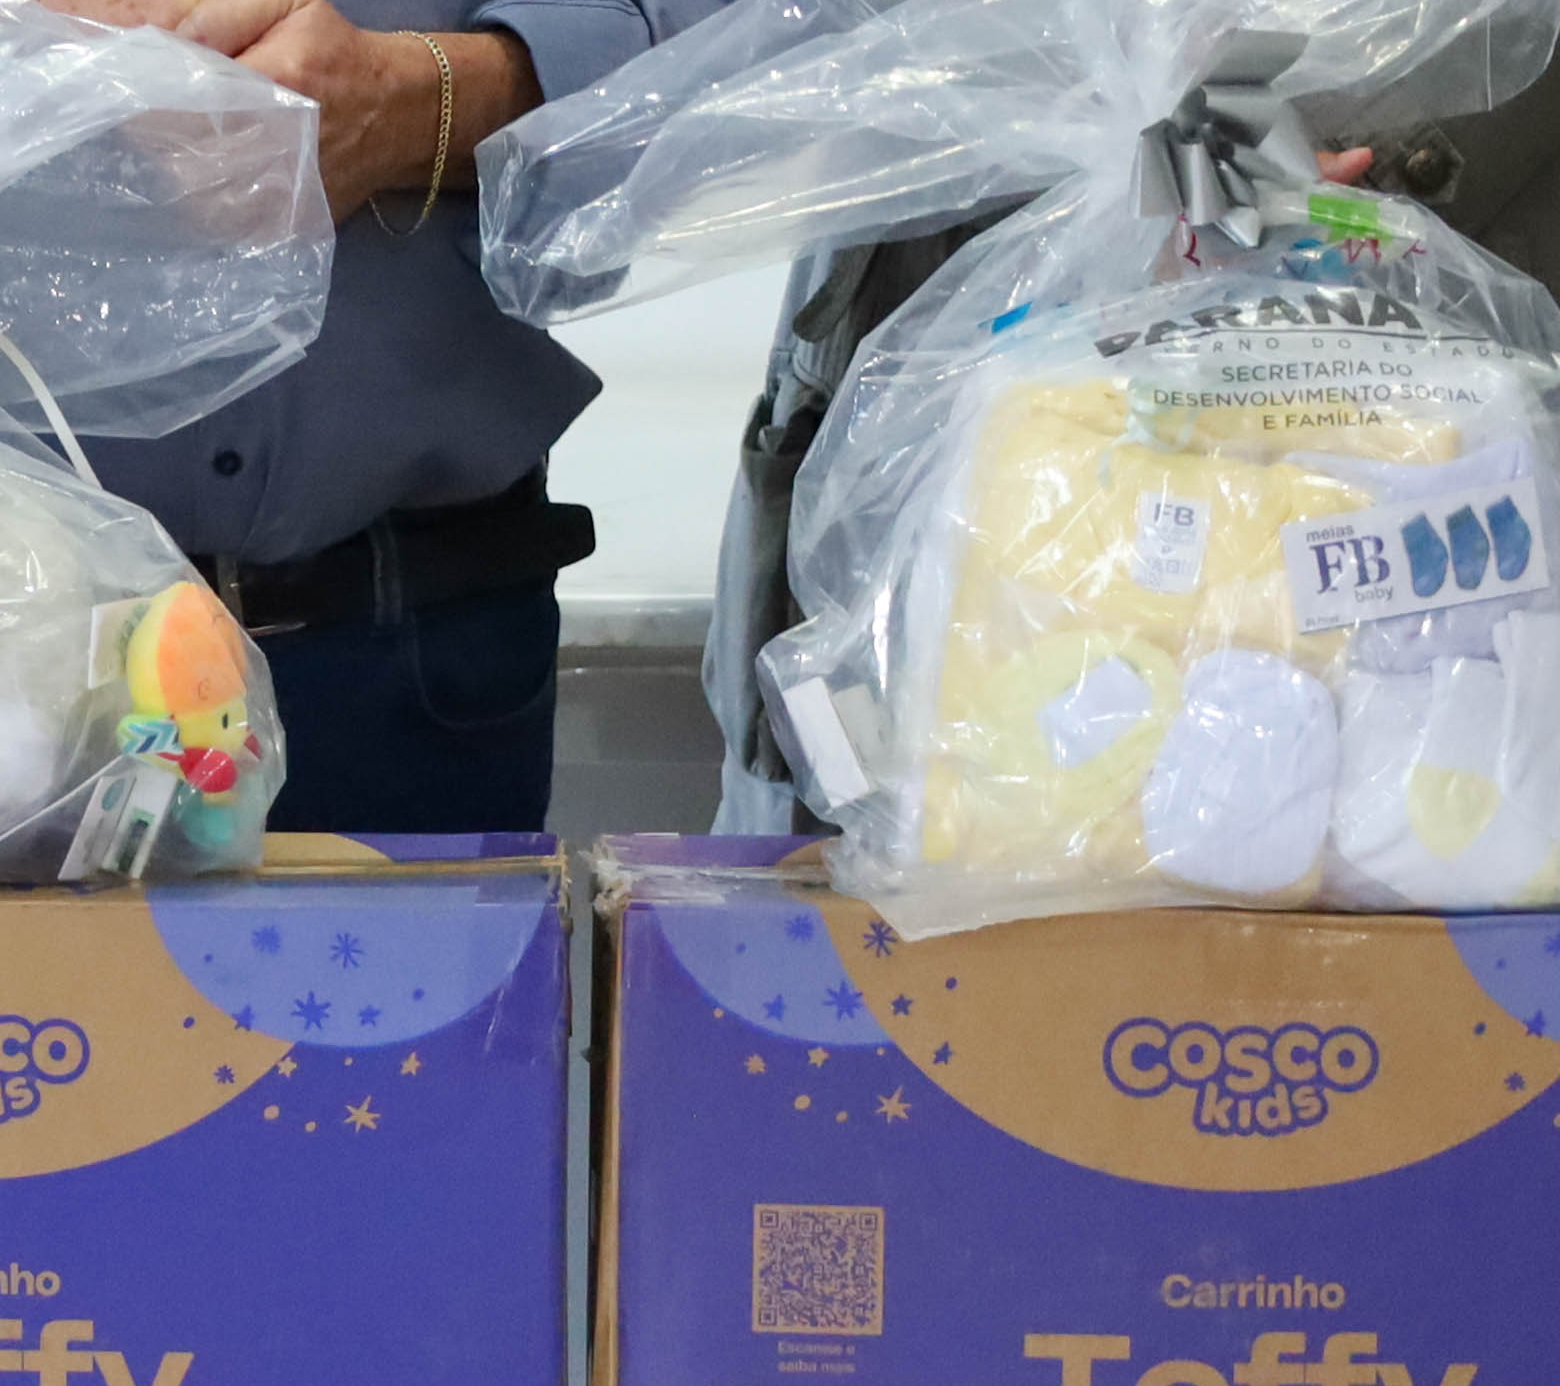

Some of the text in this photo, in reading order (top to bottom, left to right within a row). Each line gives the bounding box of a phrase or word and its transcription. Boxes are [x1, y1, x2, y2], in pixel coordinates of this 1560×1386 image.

[1221, 360, 1414, 383] SECRETARIA DO
[1154, 383, 1485, 409] DESENVOLVIMENTO SOCIAL
[1263, 409, 1382, 431] E FAMÍLIA
[1153, 502, 1195, 526] FB
[1305, 524, 1355, 543] meias
[1309, 535, 1391, 594] FB
[1354, 585, 1394, 604] baby
[1194, 1078, 1330, 1138] kids
[1161, 1272, 1347, 1311] Carrinho
